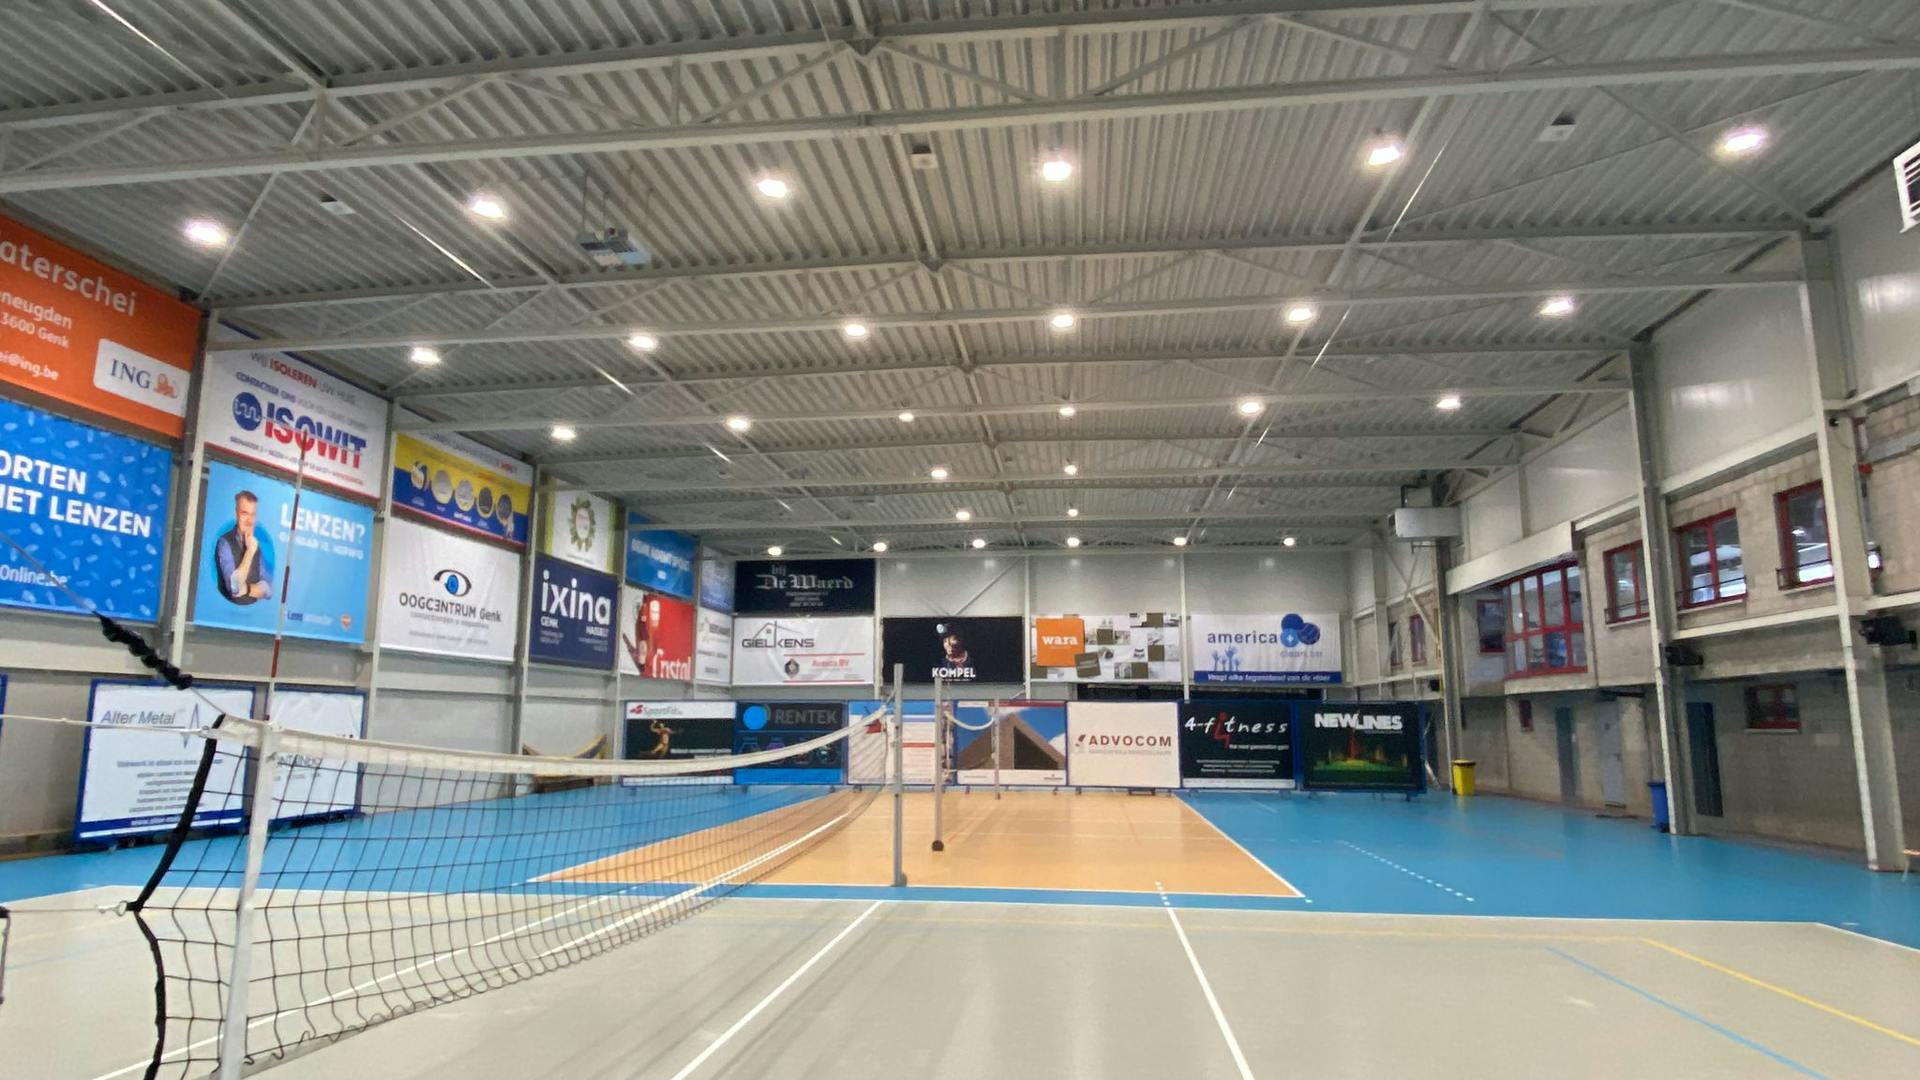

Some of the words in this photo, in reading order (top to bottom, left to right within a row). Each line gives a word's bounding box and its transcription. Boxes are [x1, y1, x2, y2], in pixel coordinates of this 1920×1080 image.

[0, 291, 73, 329] neugden
[37, 327, 70, 349] Genk
[110, 359, 151, 389] ING
[270, 358, 317, 388] ISOLEREN
[264, 402, 367, 469] ISOWIT
[49, 496, 152, 538] LENZEN
[280, 503, 366, 544] LENZEN?
[541, 569, 611, 626] ixina
[479, 608, 502, 623] Genk
[741, 638, 815, 649] GIELKENS
[1042, 635, 1079, 646] wara
[1207, 630, 1278, 644] america
[931, 666, 976, 678] KOMPEL
[100, 710, 136, 724] Alter
[137, 710, 176, 724] Metal
[774, 709, 837, 724] RENTEK
[1088, 735, 1171, 747] ADVOCOM
